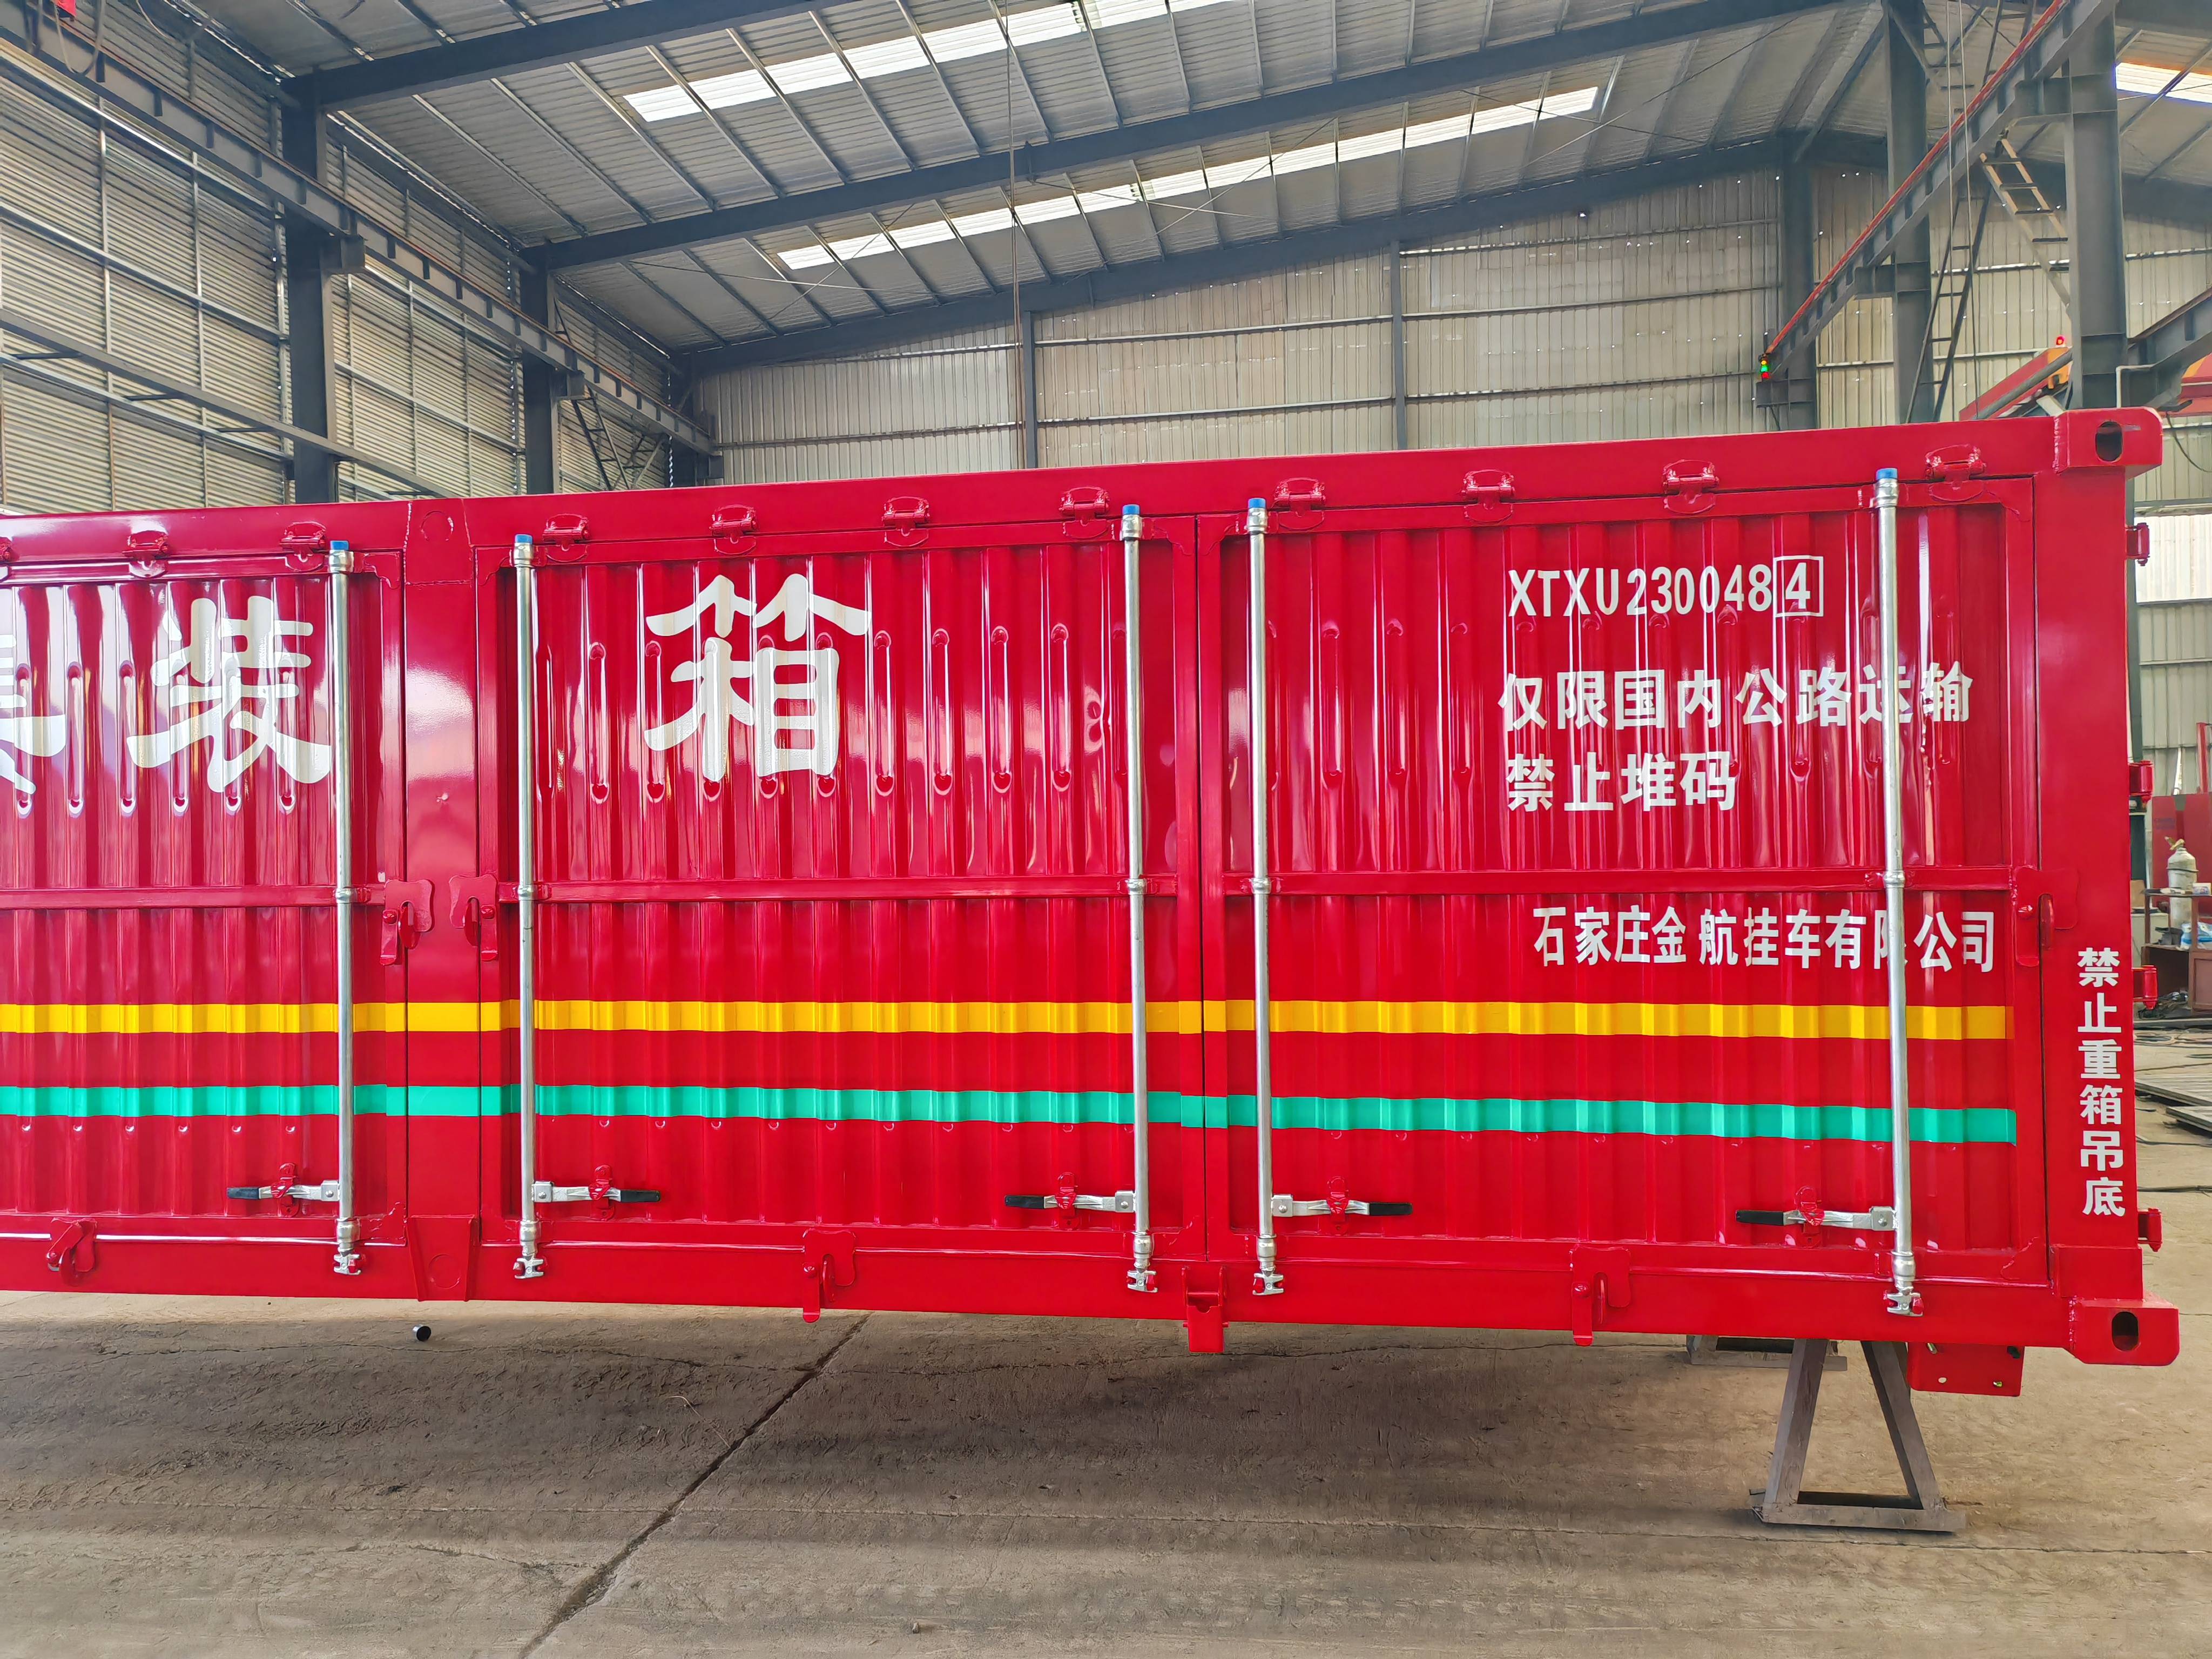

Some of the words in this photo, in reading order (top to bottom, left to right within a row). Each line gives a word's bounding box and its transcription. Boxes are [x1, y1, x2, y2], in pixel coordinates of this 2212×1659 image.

[1498, 660, 1974, 731] 仅限国内公路运输
[1506, 750, 1737, 812] 禁止堆码
[2077, 947, 2126, 1217] 禁止重箱吊底
